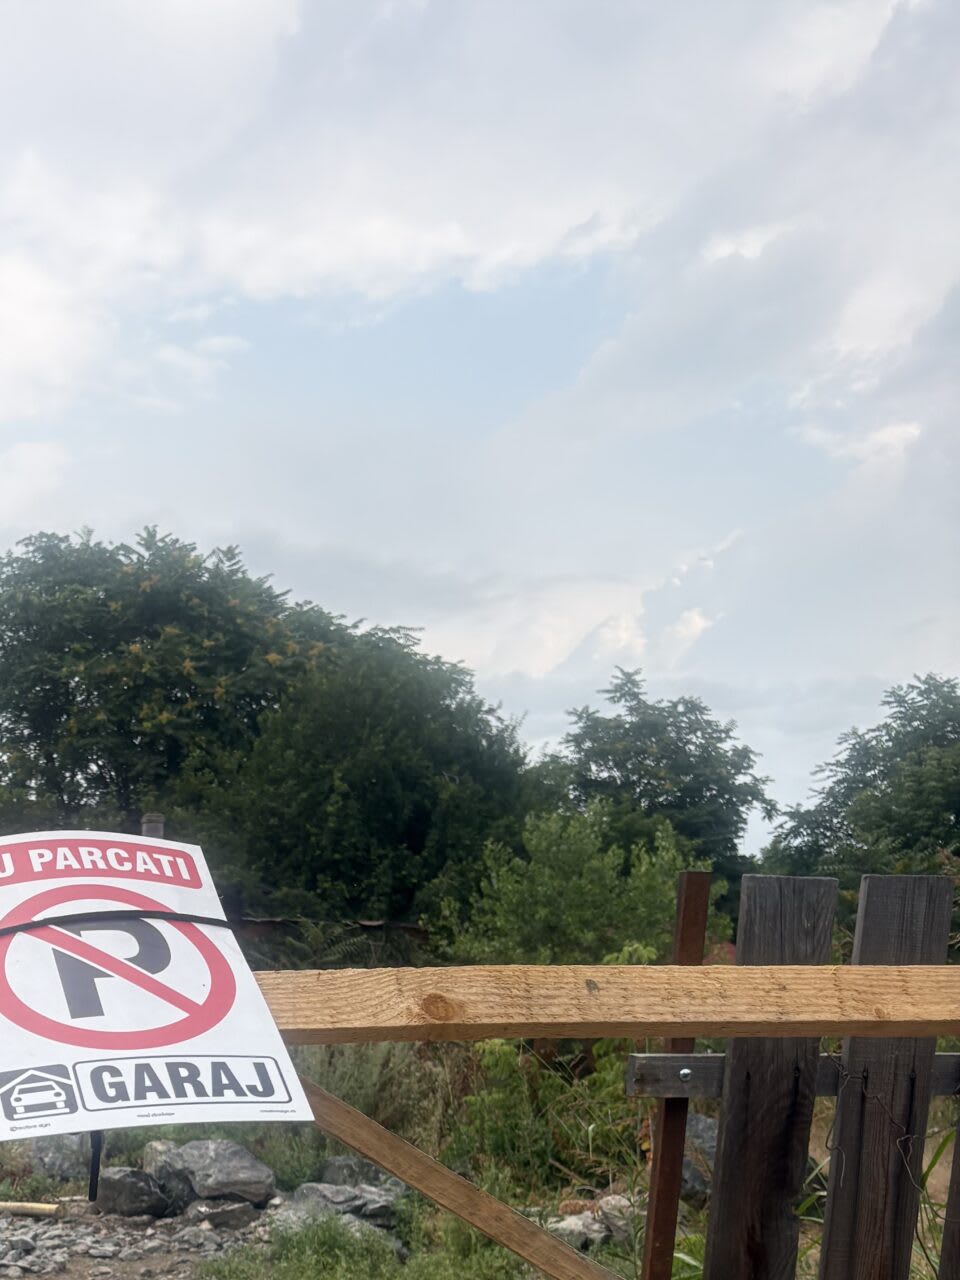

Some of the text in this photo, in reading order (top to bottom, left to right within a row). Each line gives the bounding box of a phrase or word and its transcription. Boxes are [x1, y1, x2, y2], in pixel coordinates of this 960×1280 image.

[28, 846, 191, 881] PARCATI
[49, 912, 172, 1019] P
[89, 1061, 276, 1104] GARAJ
